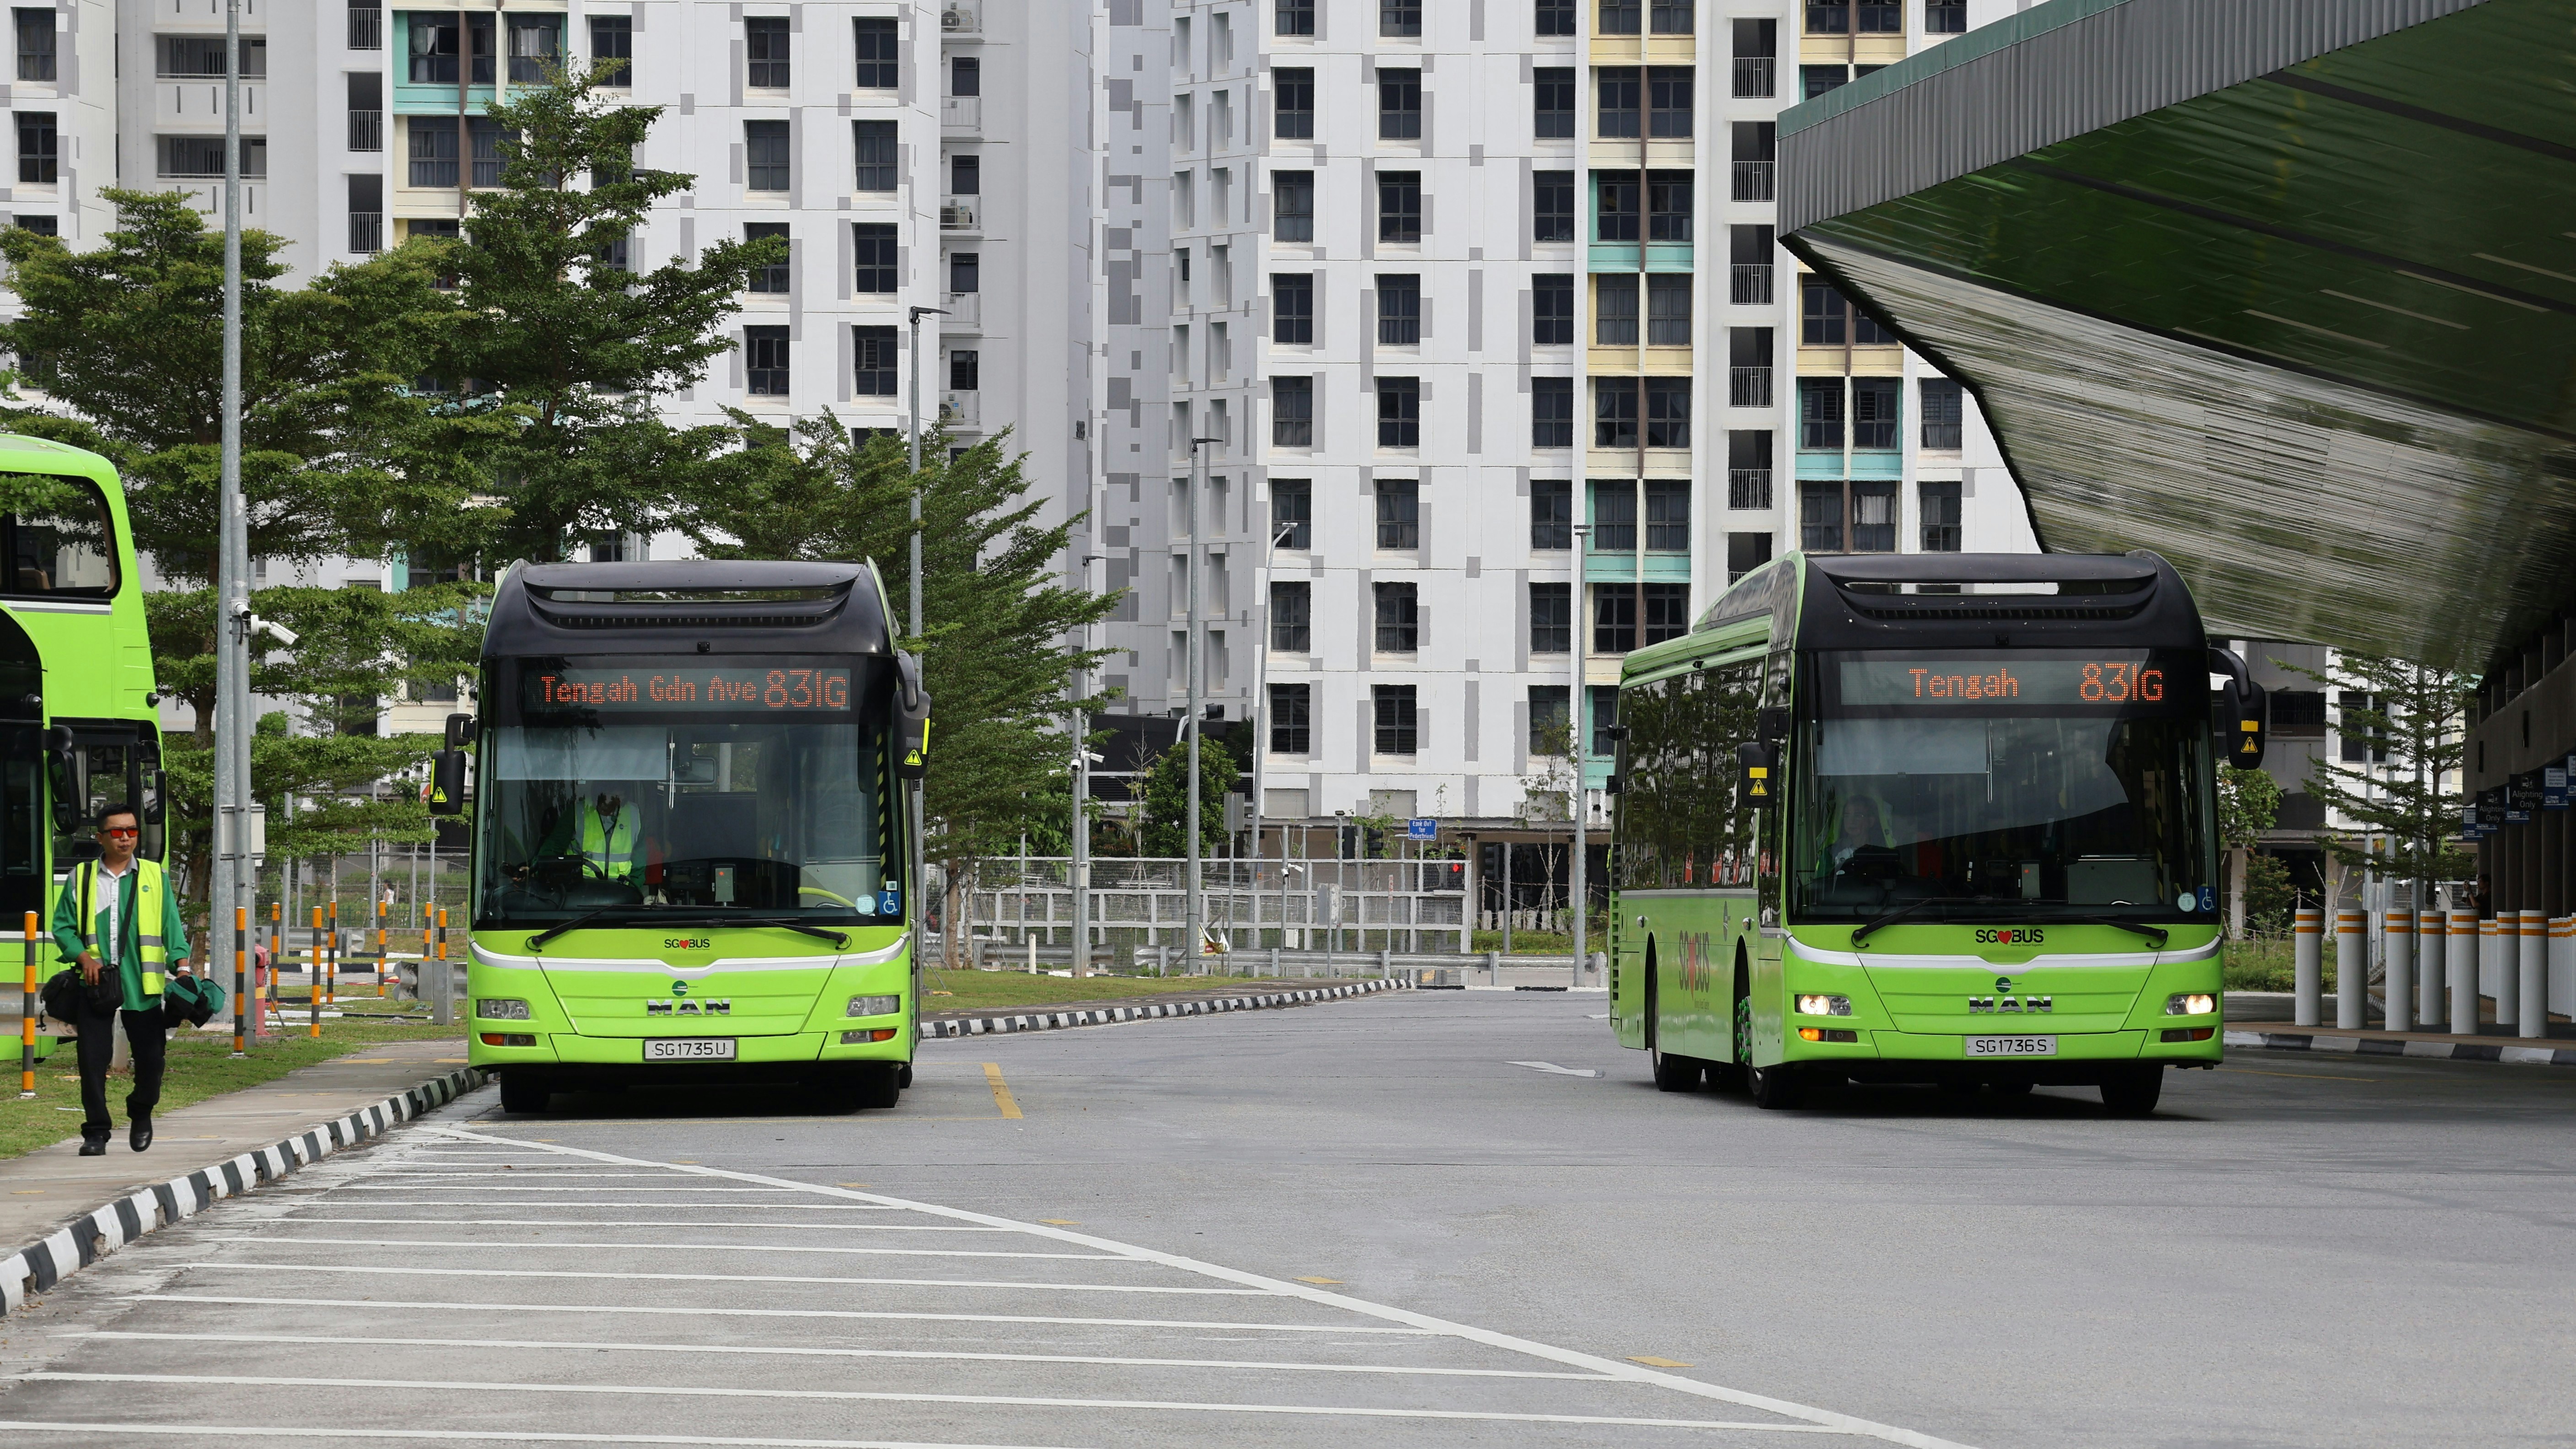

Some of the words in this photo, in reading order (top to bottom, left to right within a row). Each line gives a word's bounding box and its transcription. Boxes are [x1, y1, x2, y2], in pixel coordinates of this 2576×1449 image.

[764, 670, 846, 707] 831G
[1909, 668, 2018, 699] Tengah
[2080, 663, 2162, 701] 831G
[540, 676, 637, 704] Tengah
[650, 676, 695, 701] Gdn
[708, 676, 756, 701] Ave
[2512, 790, 2543, 799] Alighting
[2479, 805, 2506, 814] Alighting
[2520, 801, 2536, 809] Only
[2486, 814, 2501, 823] Only
[647, 998, 731, 1016] MAN
[1969, 996, 2052, 1013] MAN
[655, 1042, 726, 1056] SG1735U
[1976, 1039, 2047, 1053] SG1736S
